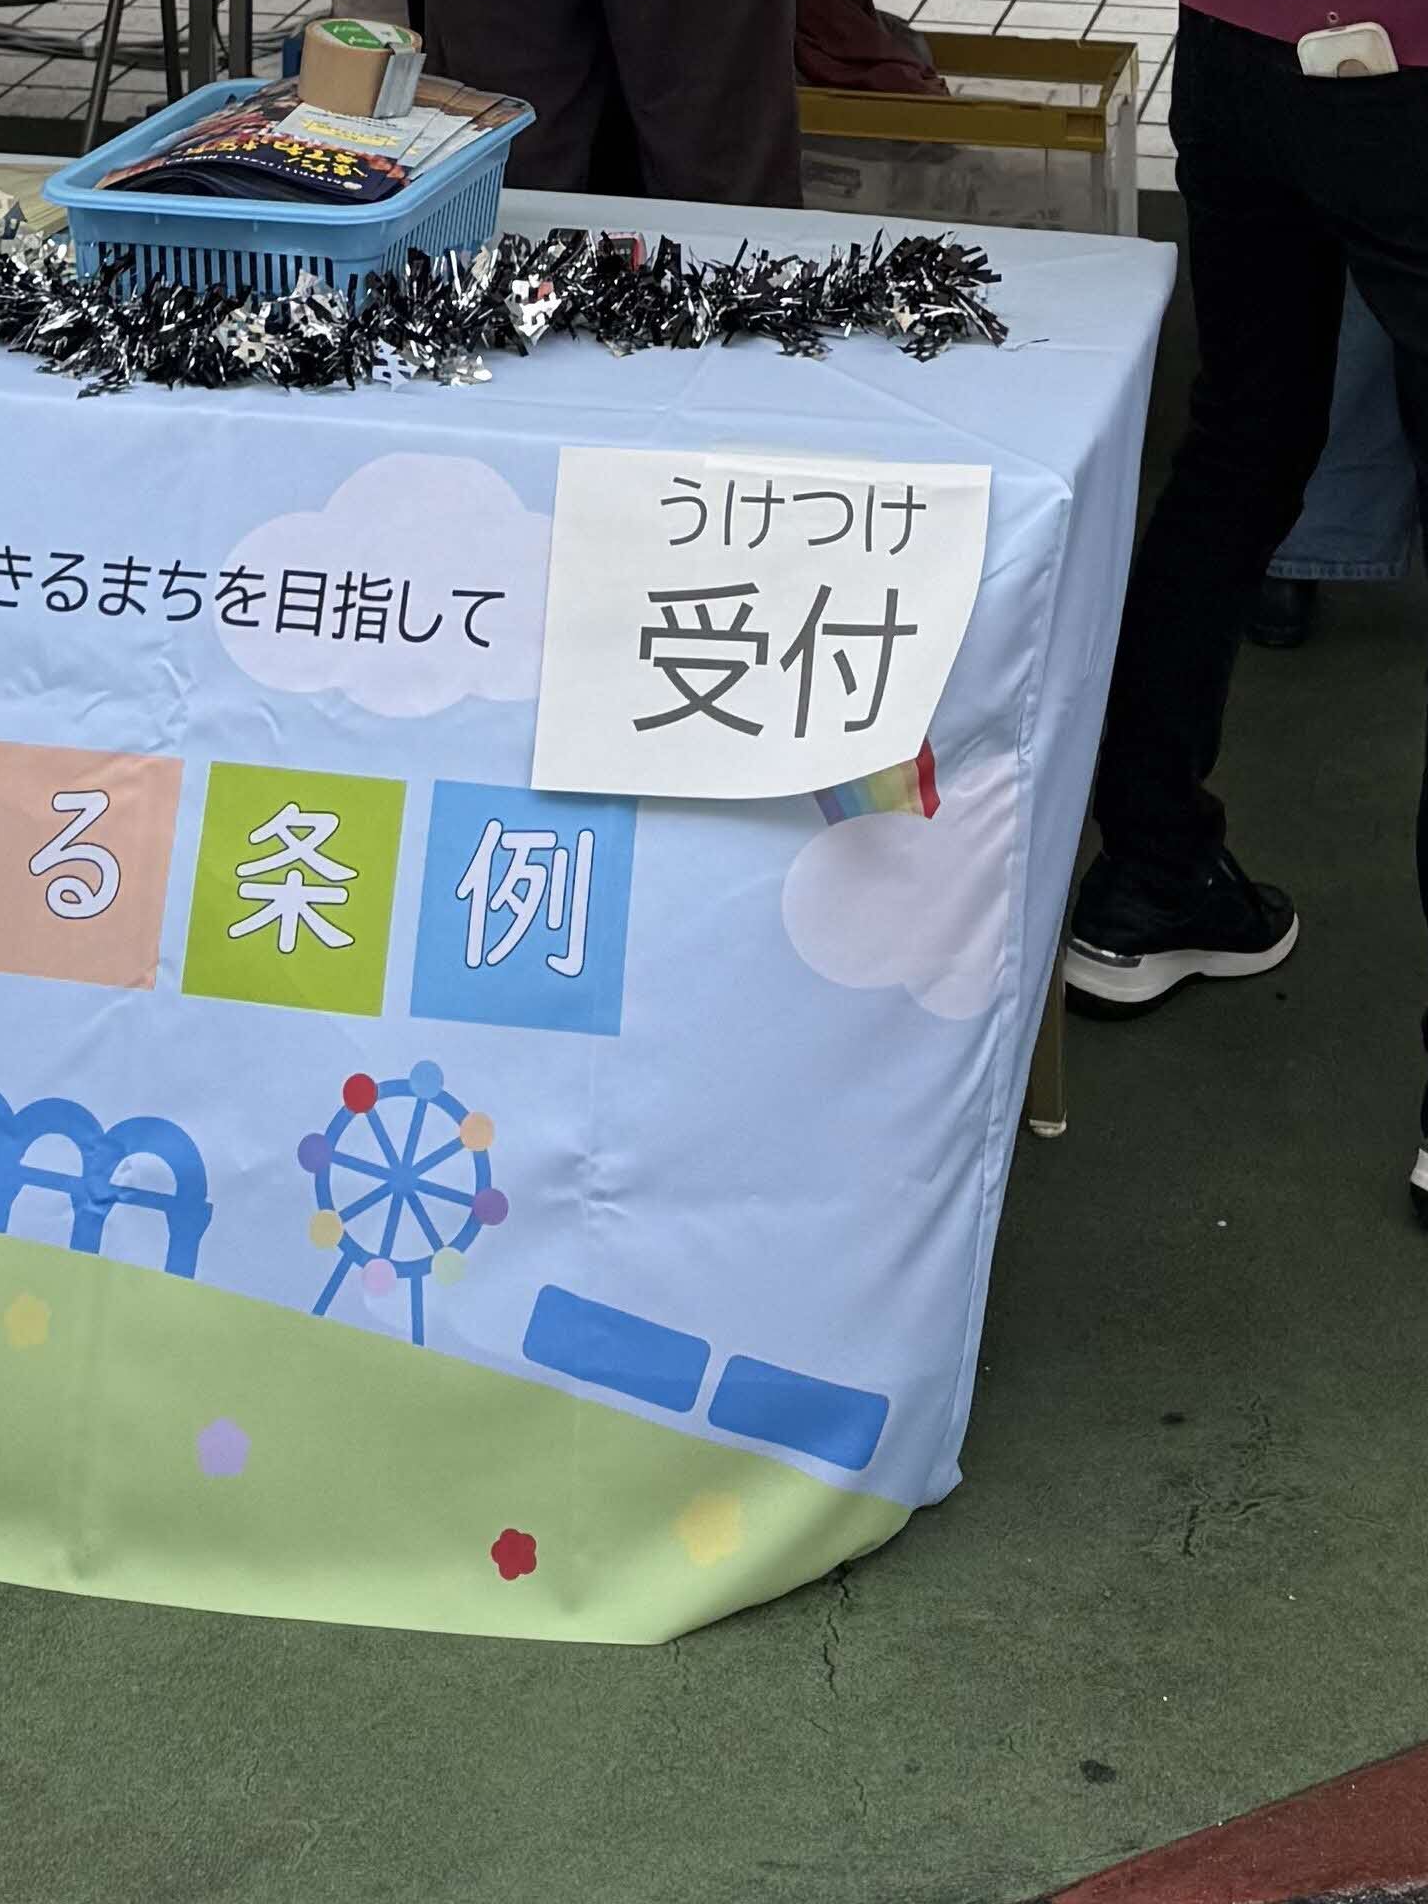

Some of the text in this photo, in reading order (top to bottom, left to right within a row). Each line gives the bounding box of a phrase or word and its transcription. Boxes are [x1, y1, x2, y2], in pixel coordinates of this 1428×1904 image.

[660, 476, 927, 556] うけつけ
[632, 581, 919, 739] 受付
